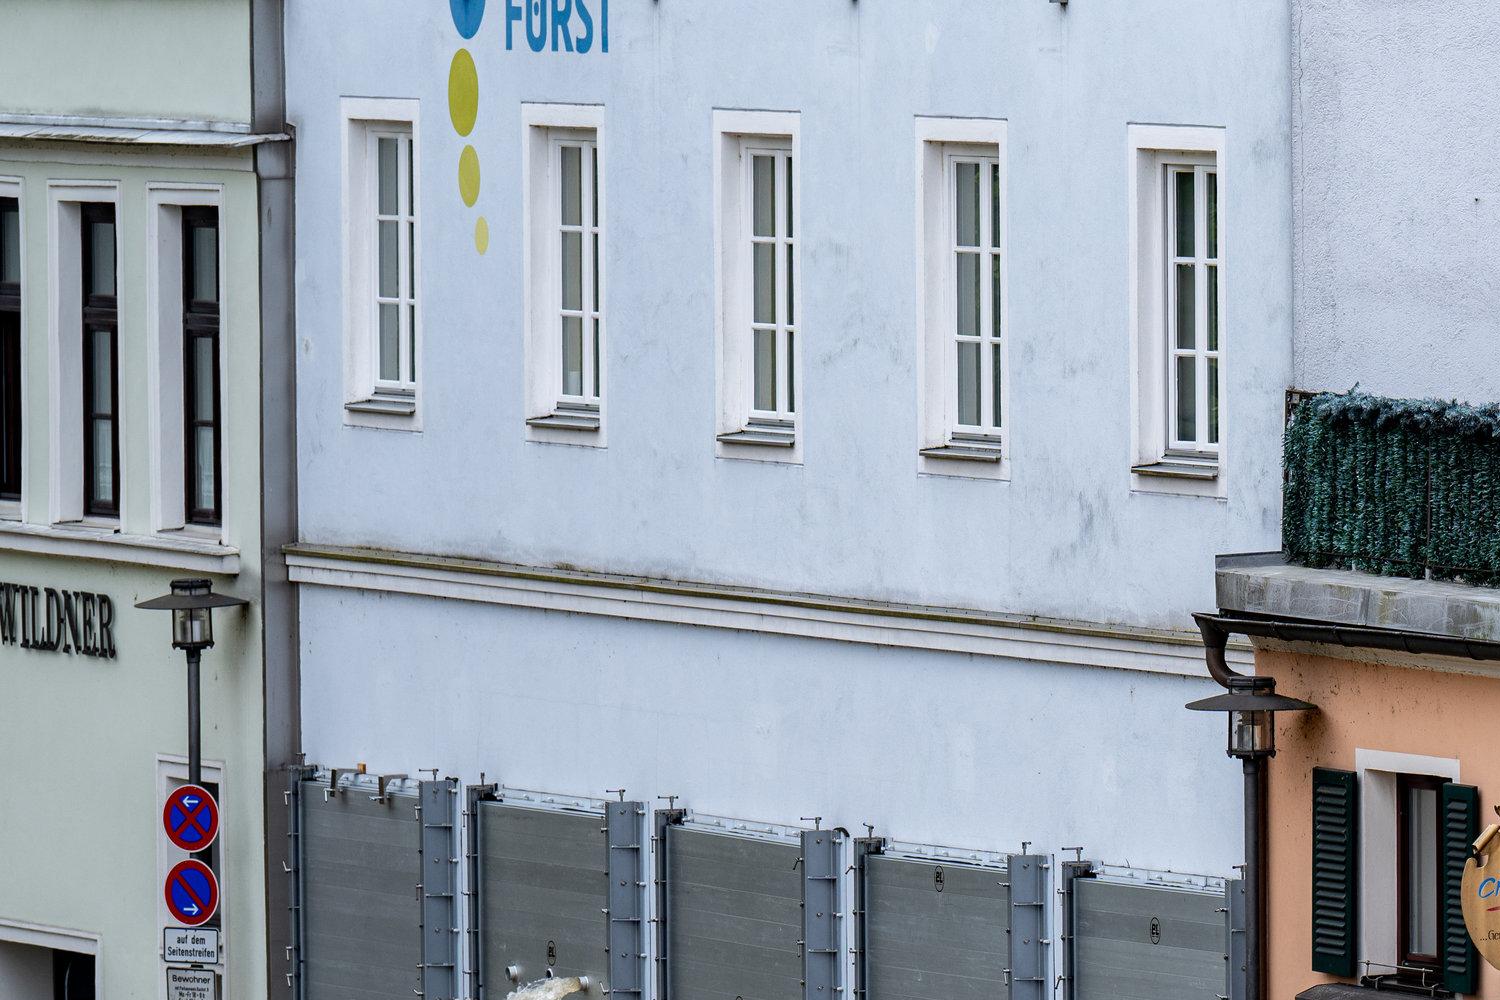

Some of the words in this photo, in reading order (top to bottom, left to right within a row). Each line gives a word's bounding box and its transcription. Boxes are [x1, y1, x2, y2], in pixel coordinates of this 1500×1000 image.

[0, 582, 116, 659] WILDNER
[176, 935, 188, 944] auf
[191, 935, 205, 944] dem
[168, 947, 215, 957] Seitenstreifen
[172, 974, 211, 984] Bewohner
